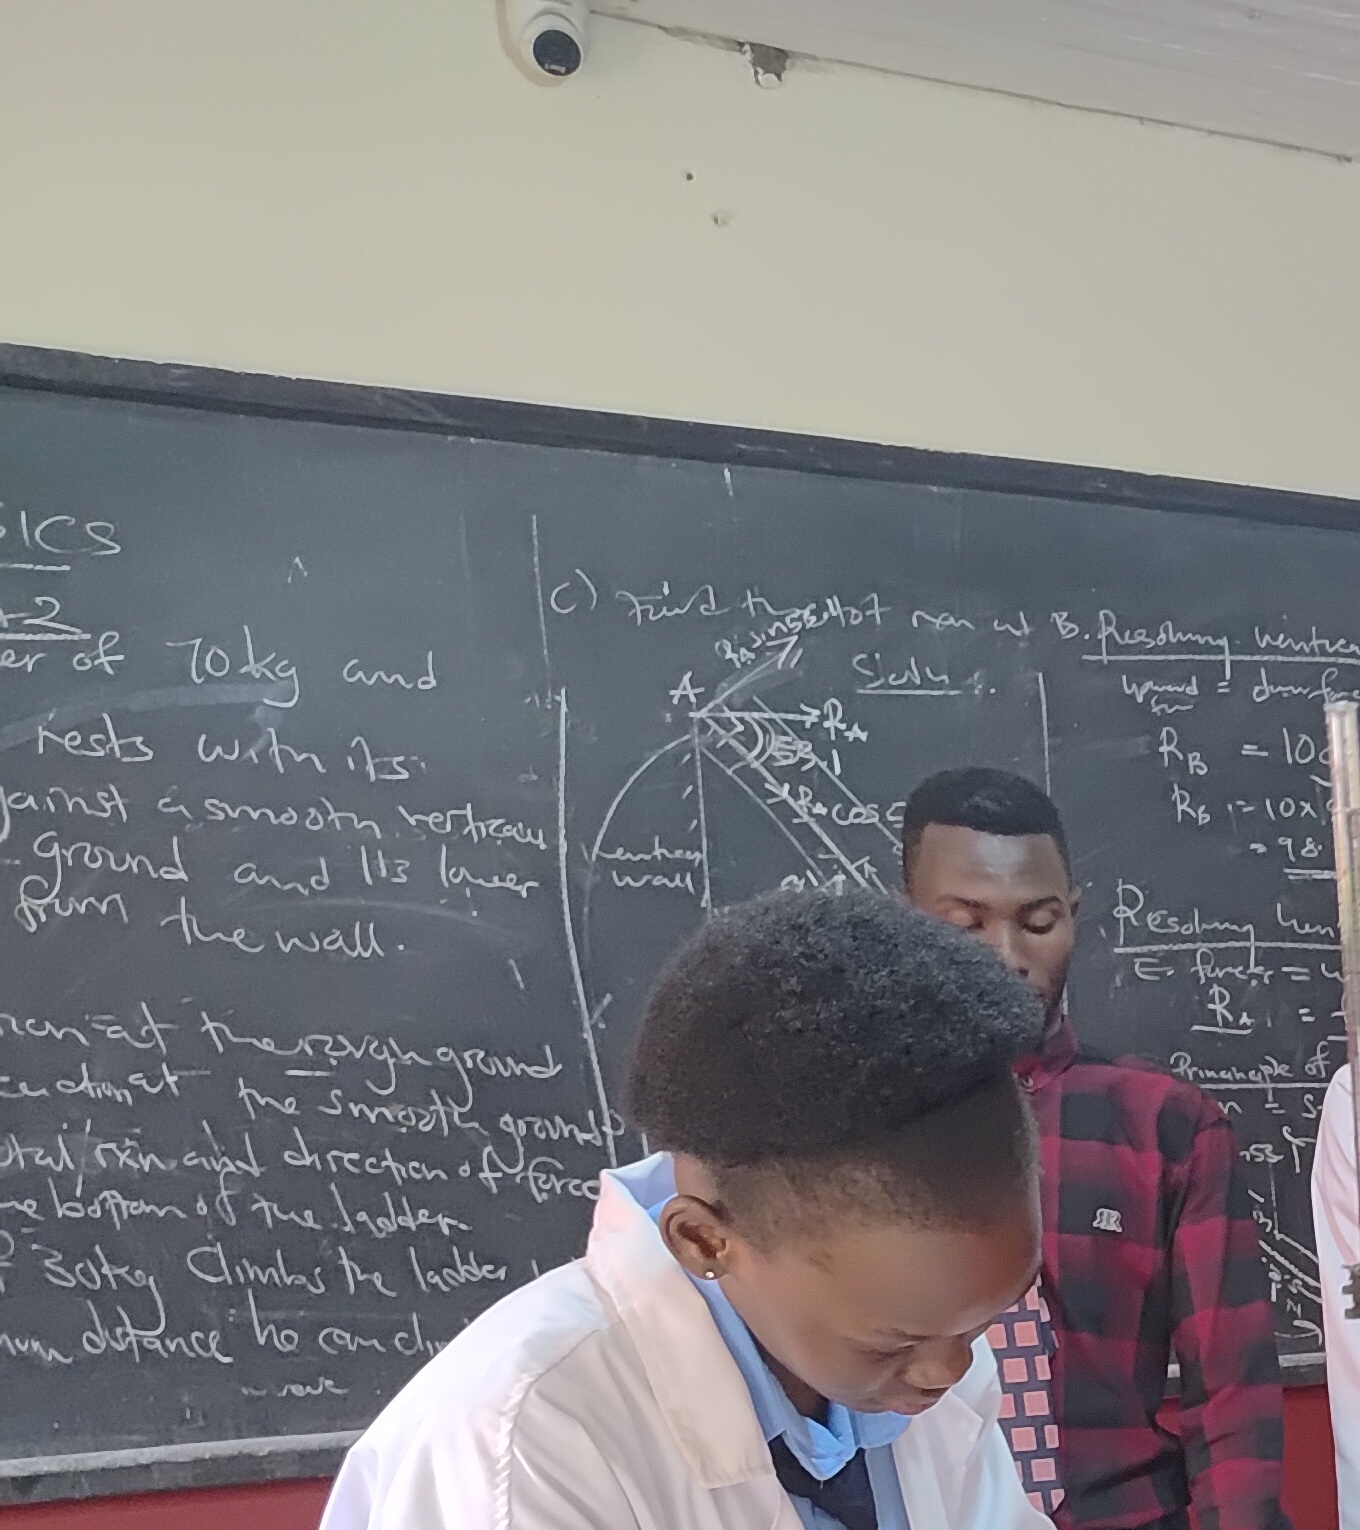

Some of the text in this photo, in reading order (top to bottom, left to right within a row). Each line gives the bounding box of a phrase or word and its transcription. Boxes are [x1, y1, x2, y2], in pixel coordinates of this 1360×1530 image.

[73, 631, 125, 676] of
[343, 651, 437, 691] and
[669, 671, 705, 705] A
[33, 830, 190, 904] ground
[234, 856, 330, 897] and
